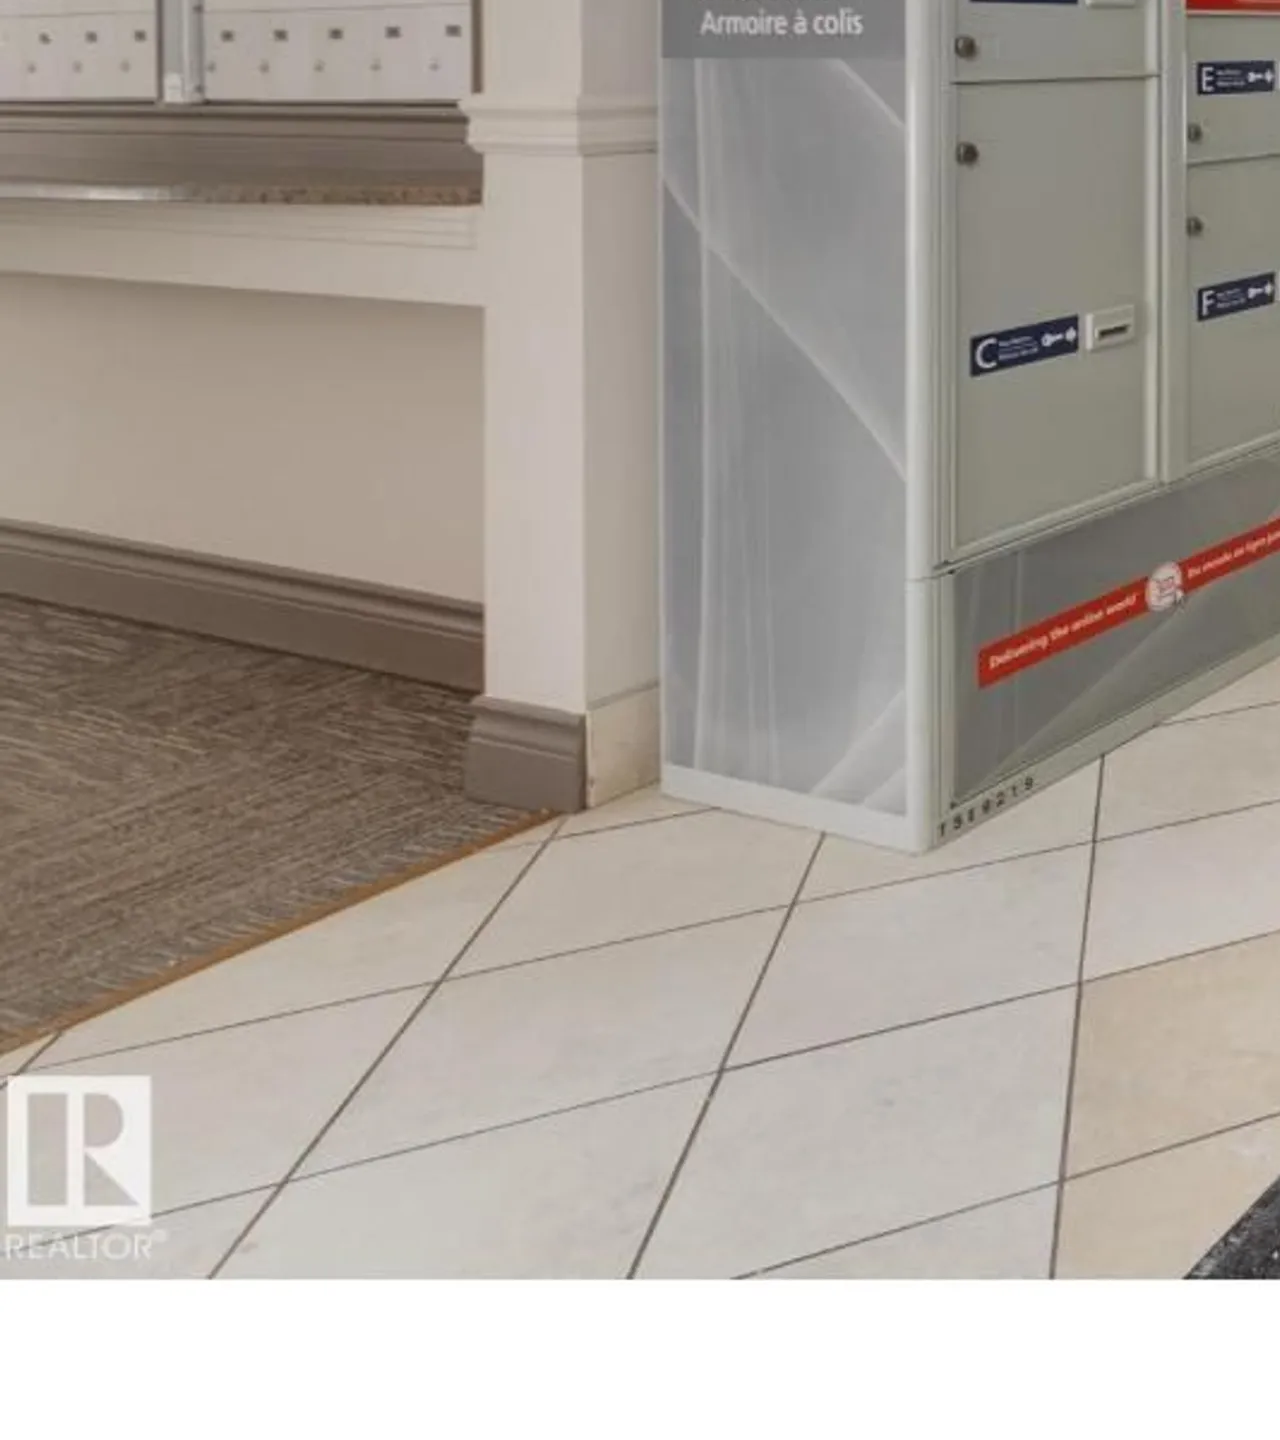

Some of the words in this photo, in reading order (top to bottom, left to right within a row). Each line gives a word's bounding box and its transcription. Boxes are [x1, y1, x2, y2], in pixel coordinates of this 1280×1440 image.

[700, 7, 788, 37] Armoire
[792, 7, 808, 36] à
[812, 7, 864, 36] colis
[1201, 66, 1215, 93] E
[1202, 290, 1215, 317] F
[975, 337, 998, 369] C
